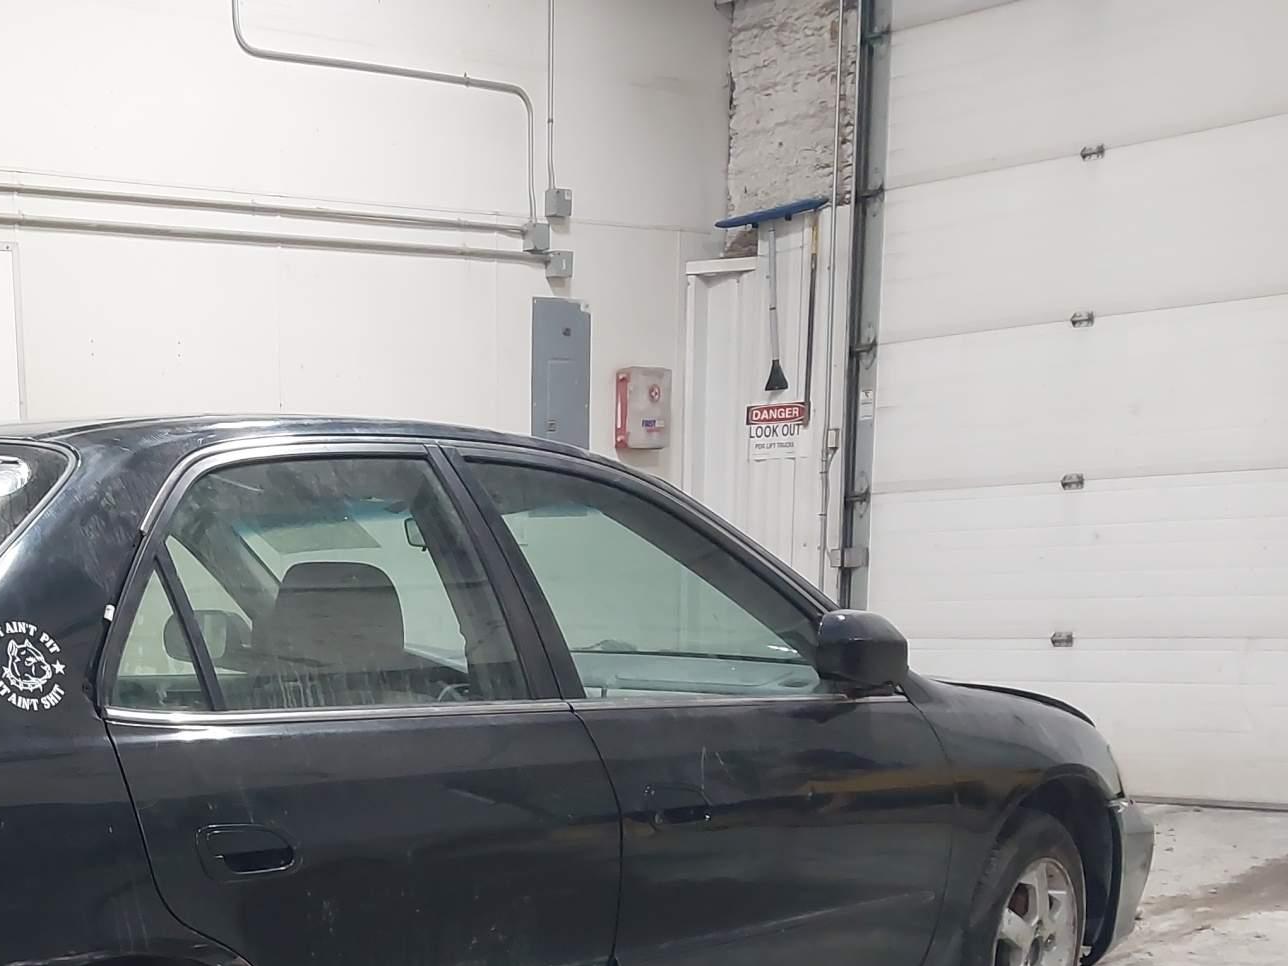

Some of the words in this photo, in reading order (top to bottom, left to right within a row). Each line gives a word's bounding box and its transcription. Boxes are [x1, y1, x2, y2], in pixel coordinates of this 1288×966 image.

[752, 407, 799, 420] DANGER
[749, 425, 779, 439] LOOK
[782, 424, 800, 437] OUT
[5, 621, 37, 636] AIN'T
[39, 632, 61, 653] PIT
[7, 693, 39, 711] AIN'T
[40, 683, 65, 709] SHIT
